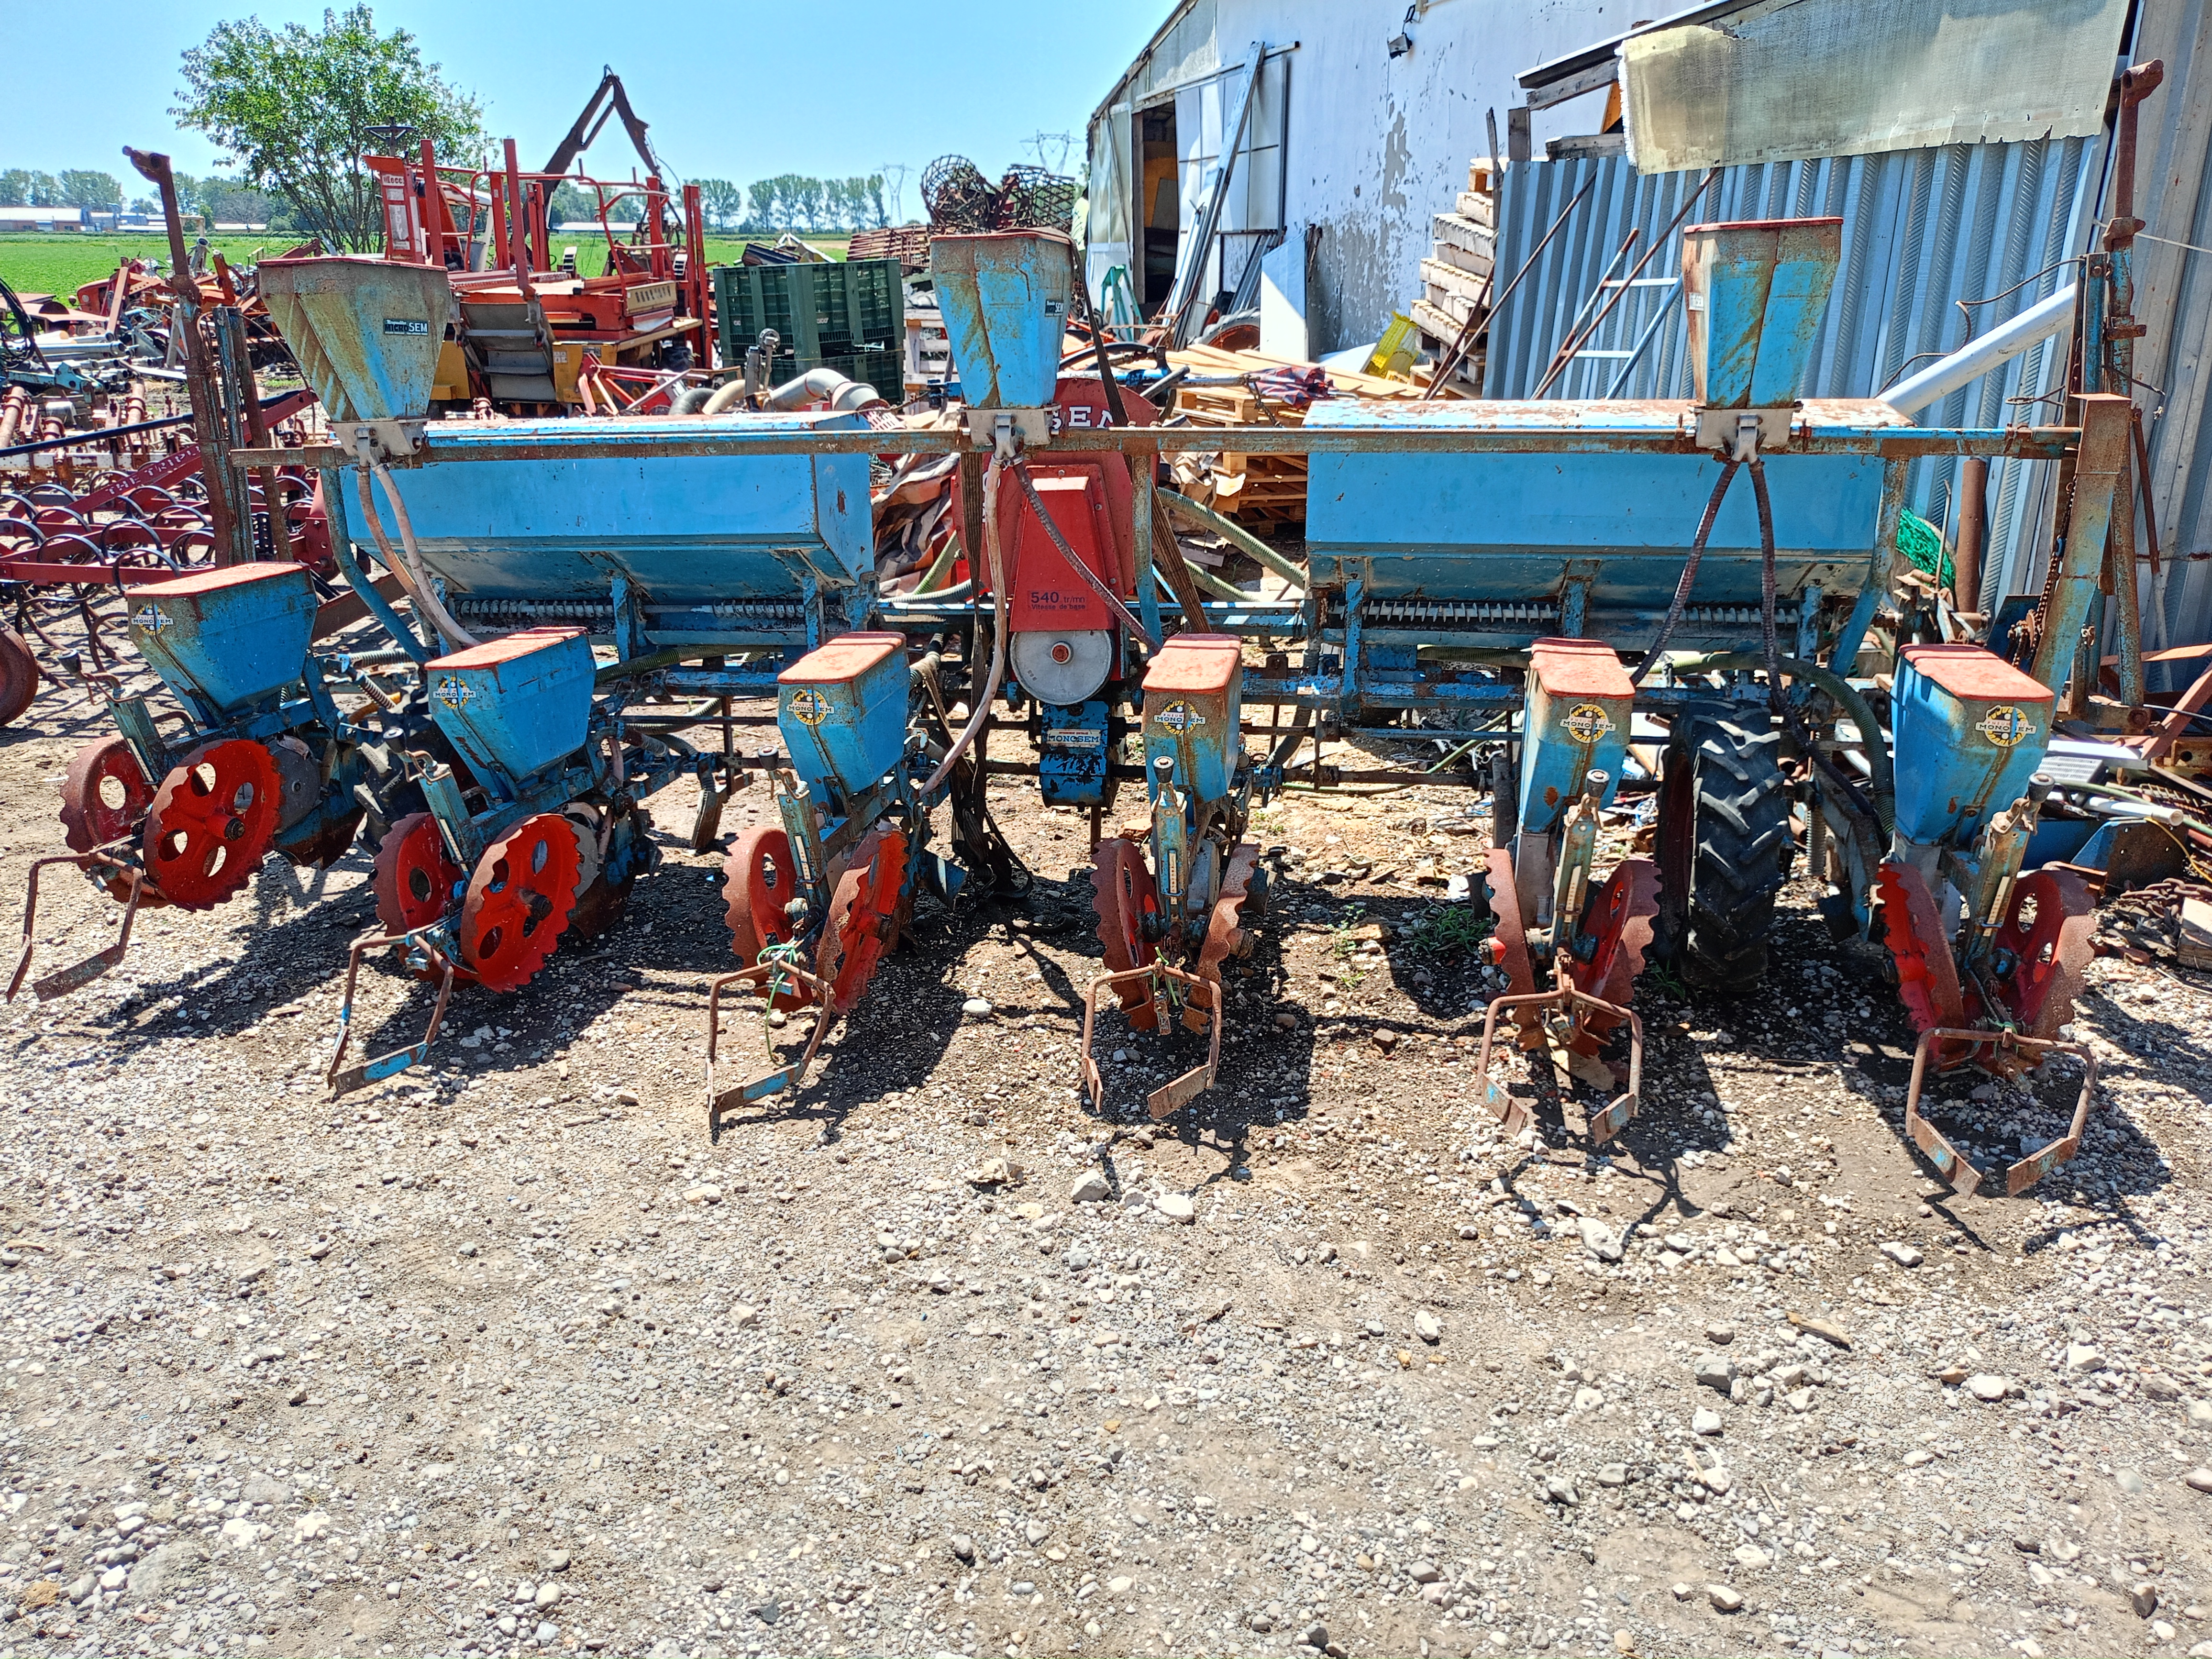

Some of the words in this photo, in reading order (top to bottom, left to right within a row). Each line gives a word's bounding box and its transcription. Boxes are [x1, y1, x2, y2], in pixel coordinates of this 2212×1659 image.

[105, 476, 141, 495] THE
[1031, 591, 1059, 603] 540
[1563, 721, 1613, 730] MONOEM
